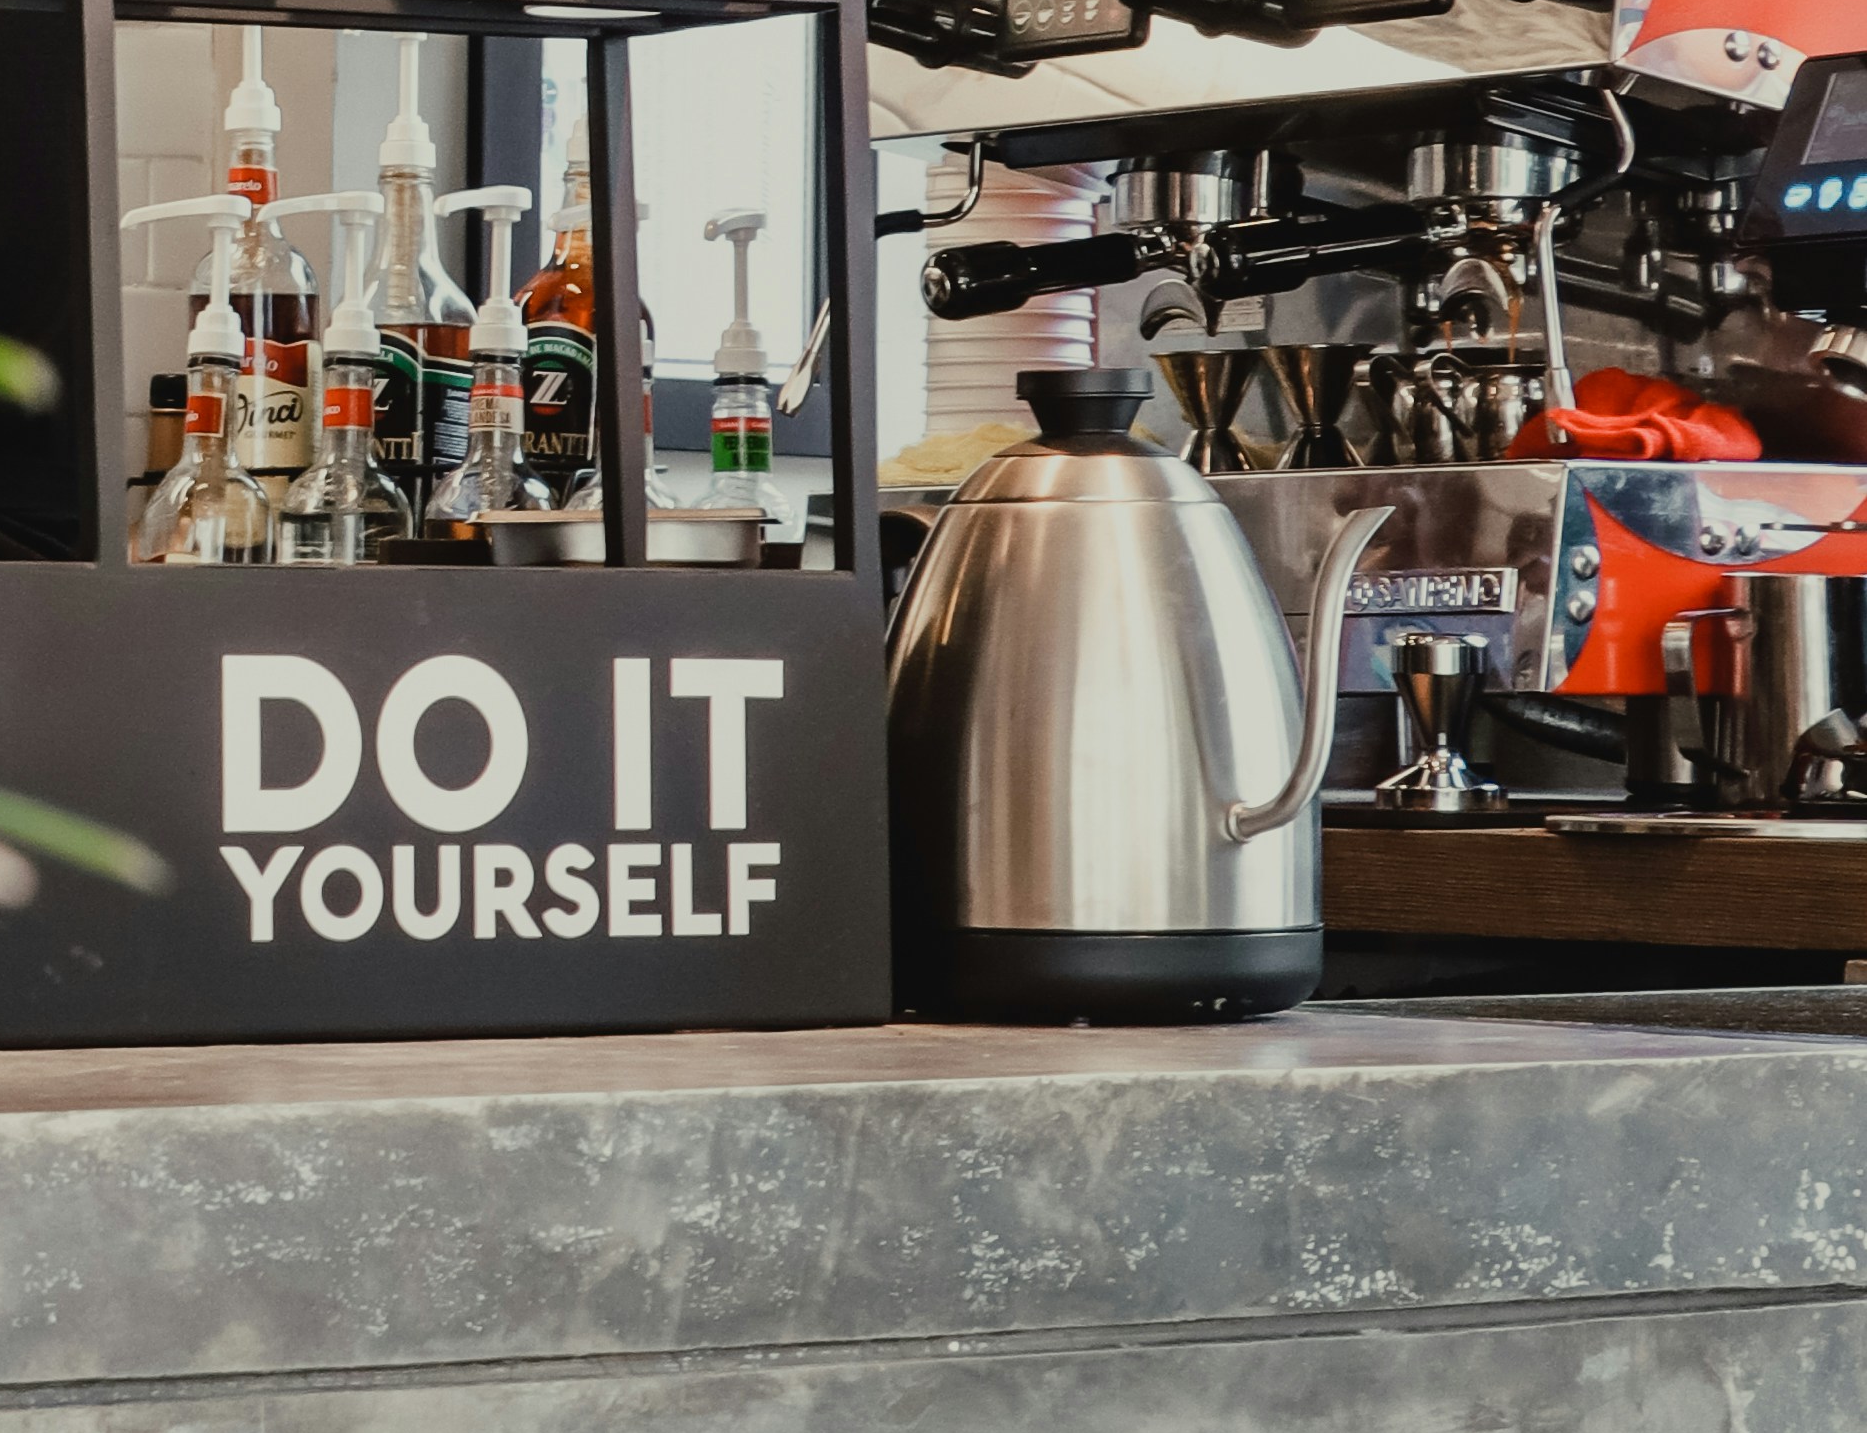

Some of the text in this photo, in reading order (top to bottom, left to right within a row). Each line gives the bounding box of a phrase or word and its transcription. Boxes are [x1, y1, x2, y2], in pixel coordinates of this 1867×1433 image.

[222, 654, 785, 834] DO IT
[219, 842, 783, 944] YOURSELF
